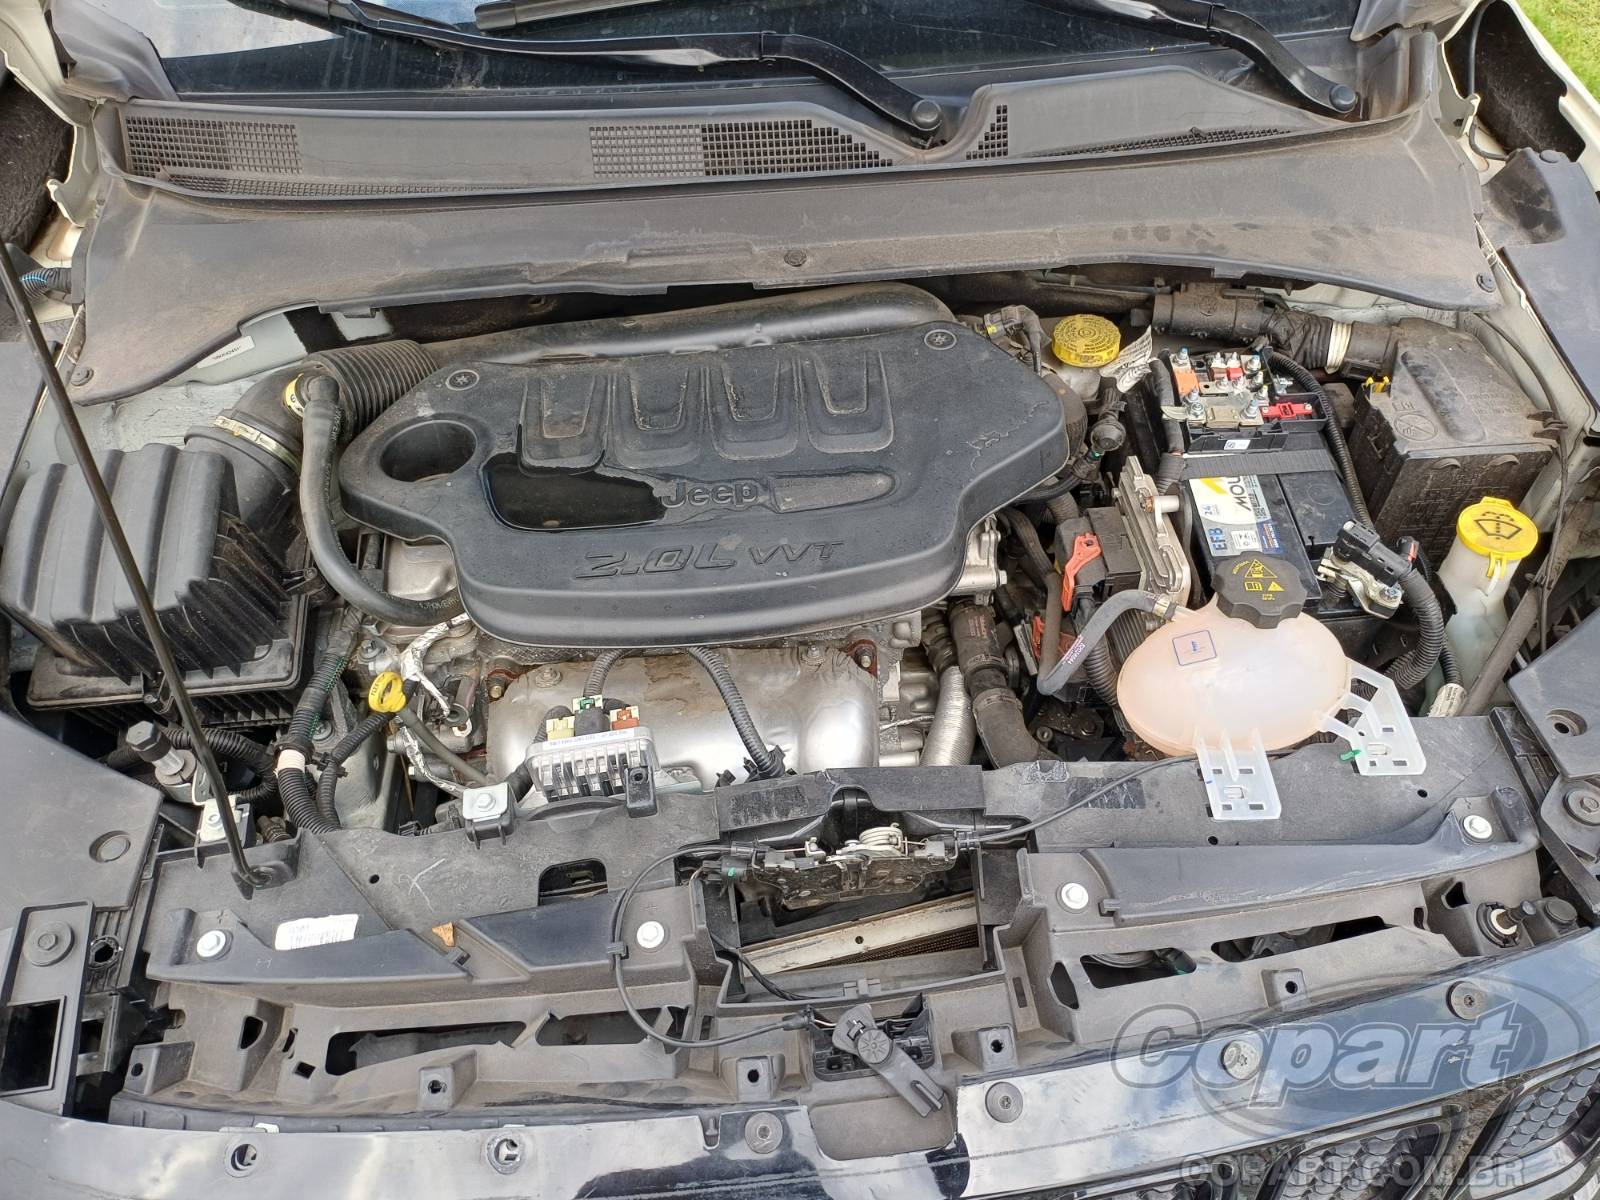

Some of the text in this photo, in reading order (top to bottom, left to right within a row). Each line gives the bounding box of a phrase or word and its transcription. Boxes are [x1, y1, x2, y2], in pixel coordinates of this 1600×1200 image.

[661, 480, 759, 507] Jeep
[1209, 527, 1228, 551] EFB
[574, 541, 845, 579] 2.0L VVT
